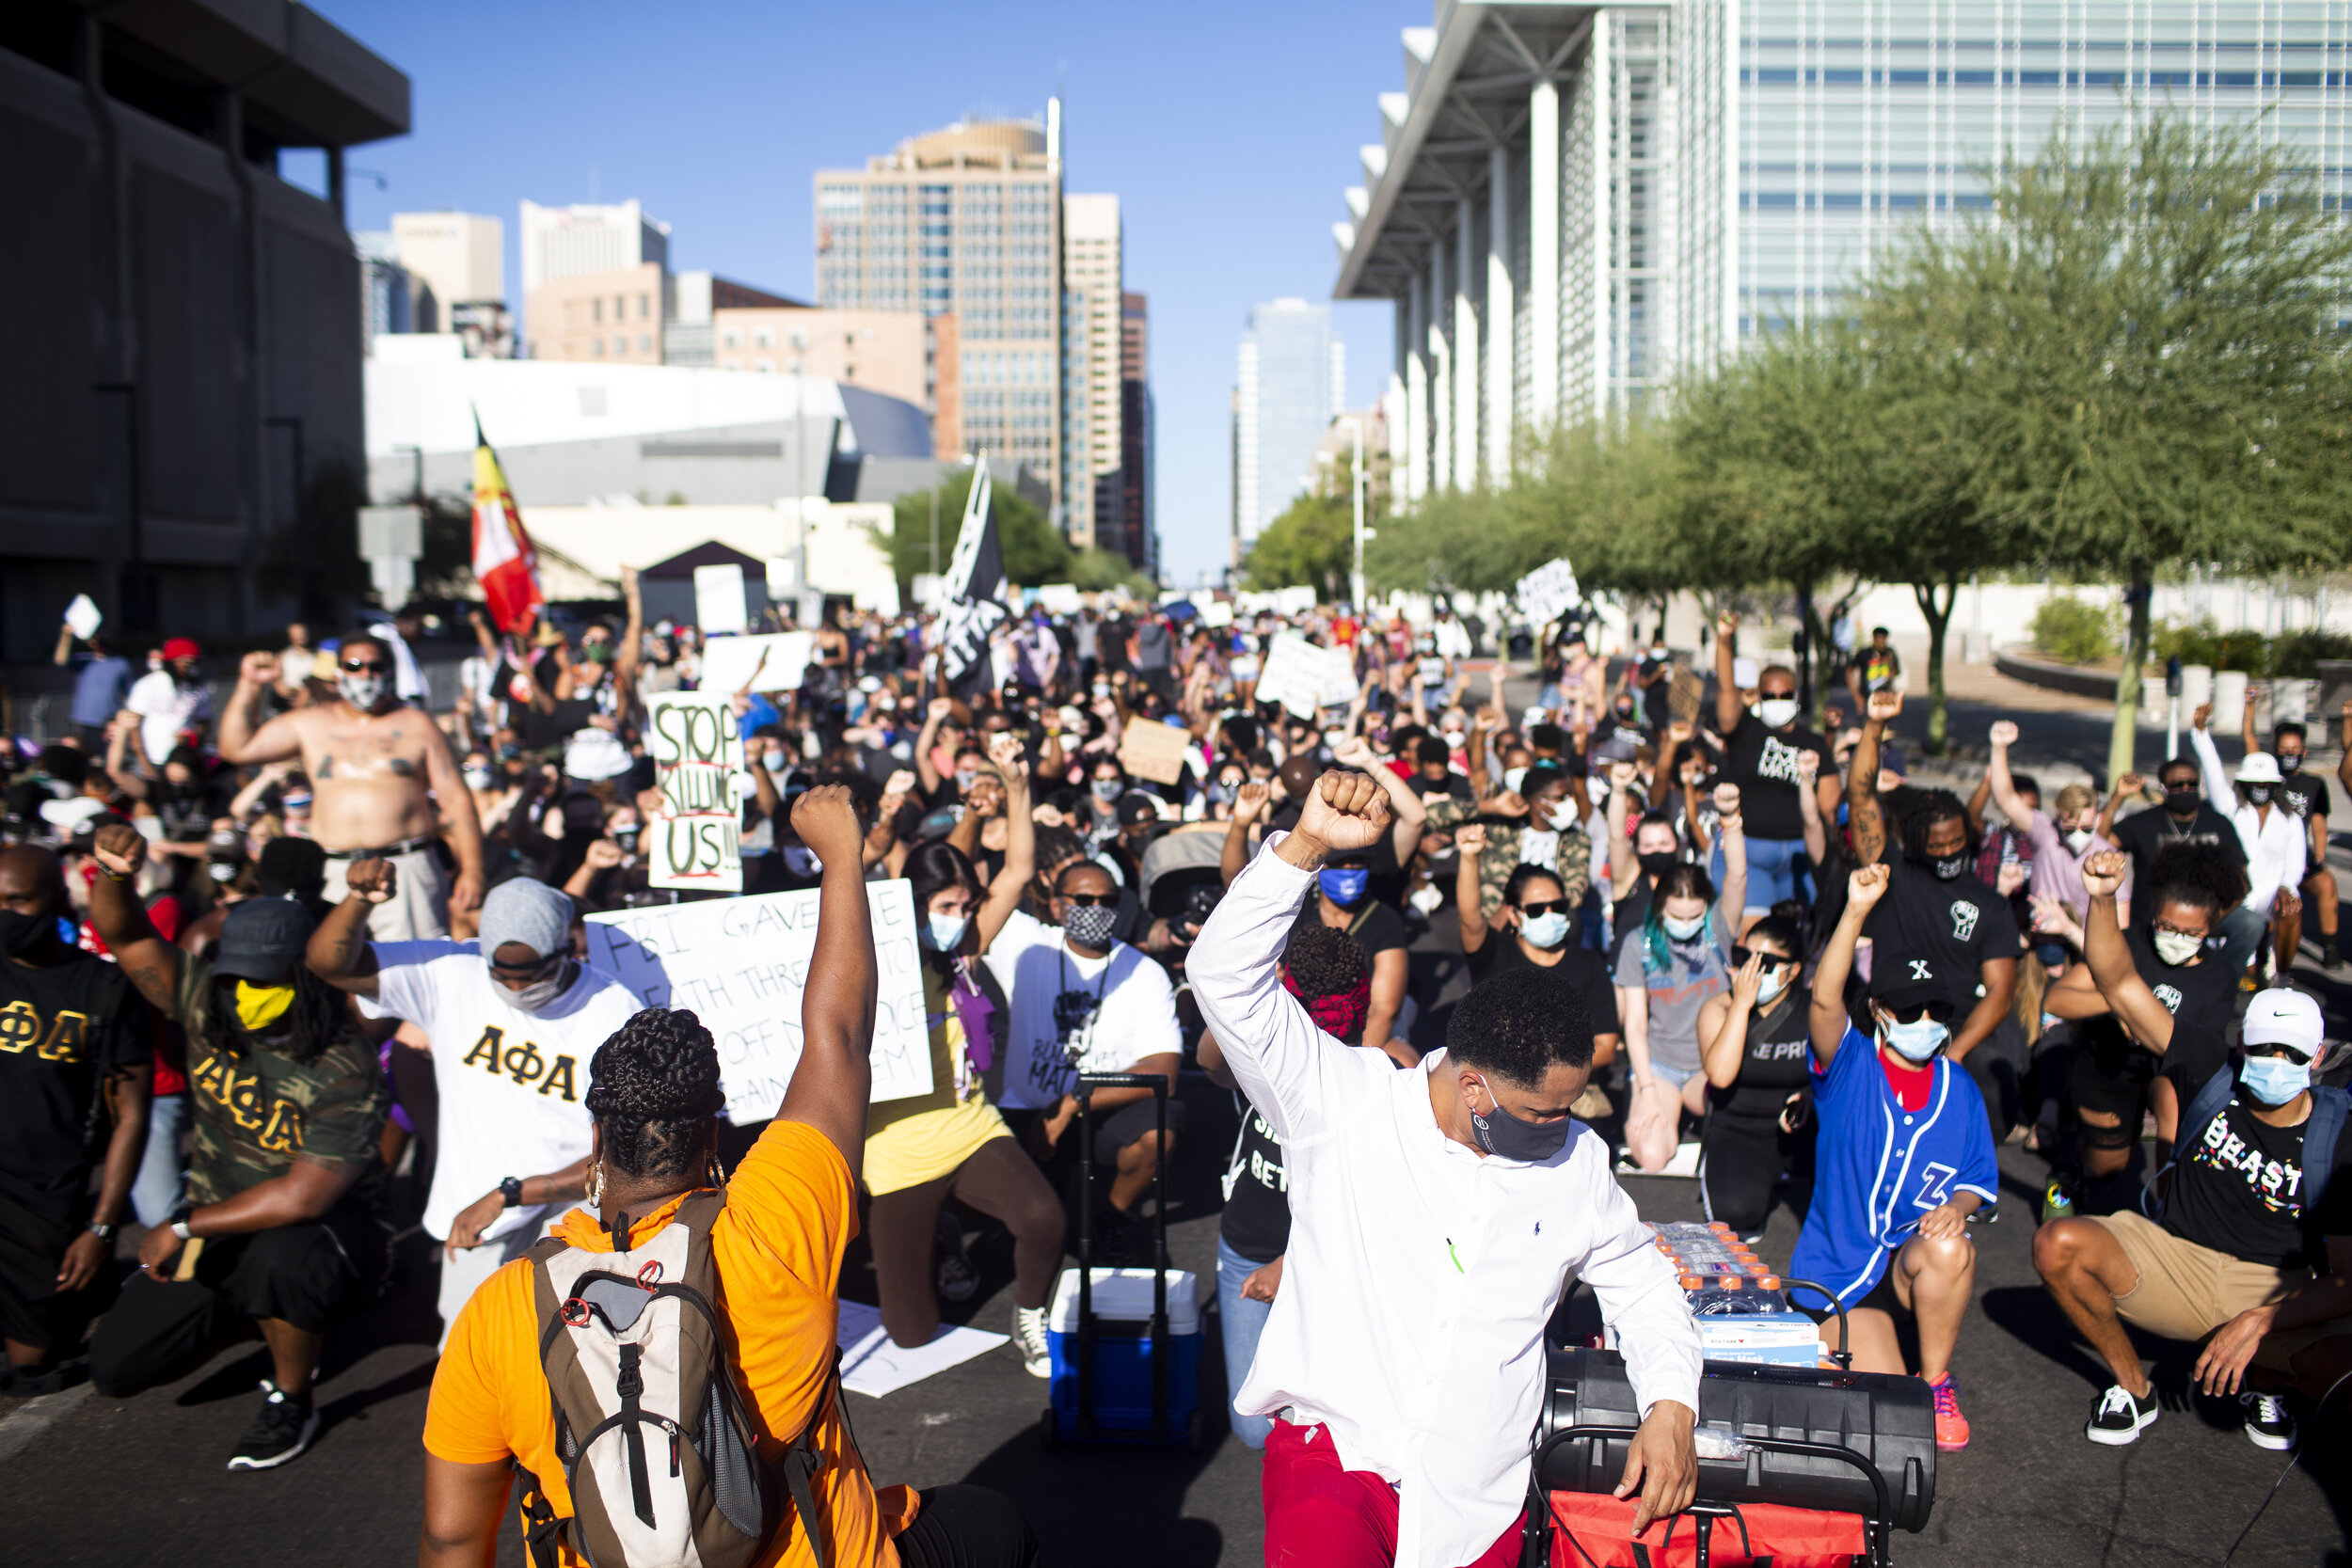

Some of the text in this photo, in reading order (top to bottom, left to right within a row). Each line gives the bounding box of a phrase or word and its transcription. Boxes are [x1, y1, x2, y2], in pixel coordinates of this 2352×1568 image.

[656, 703, 739, 768] STOP
[660, 767, 739, 817] KILLING
[603, 889, 902, 972] FBI GAVE E
[644, 936, 915, 1013] EATH THRE TO
[1908, 959, 1933, 980] X
[0, 1000, 88, 1063] ΦΑ
[723, 1019, 775, 1066] OFF
[876, 989, 929, 1037] OICE
[869, 1043, 918, 1085] EM
[1250, 1149, 1287, 1193] BET
[1912, 1161, 1958, 1212] Z
[2202, 1117, 2303, 1197] BEAST
